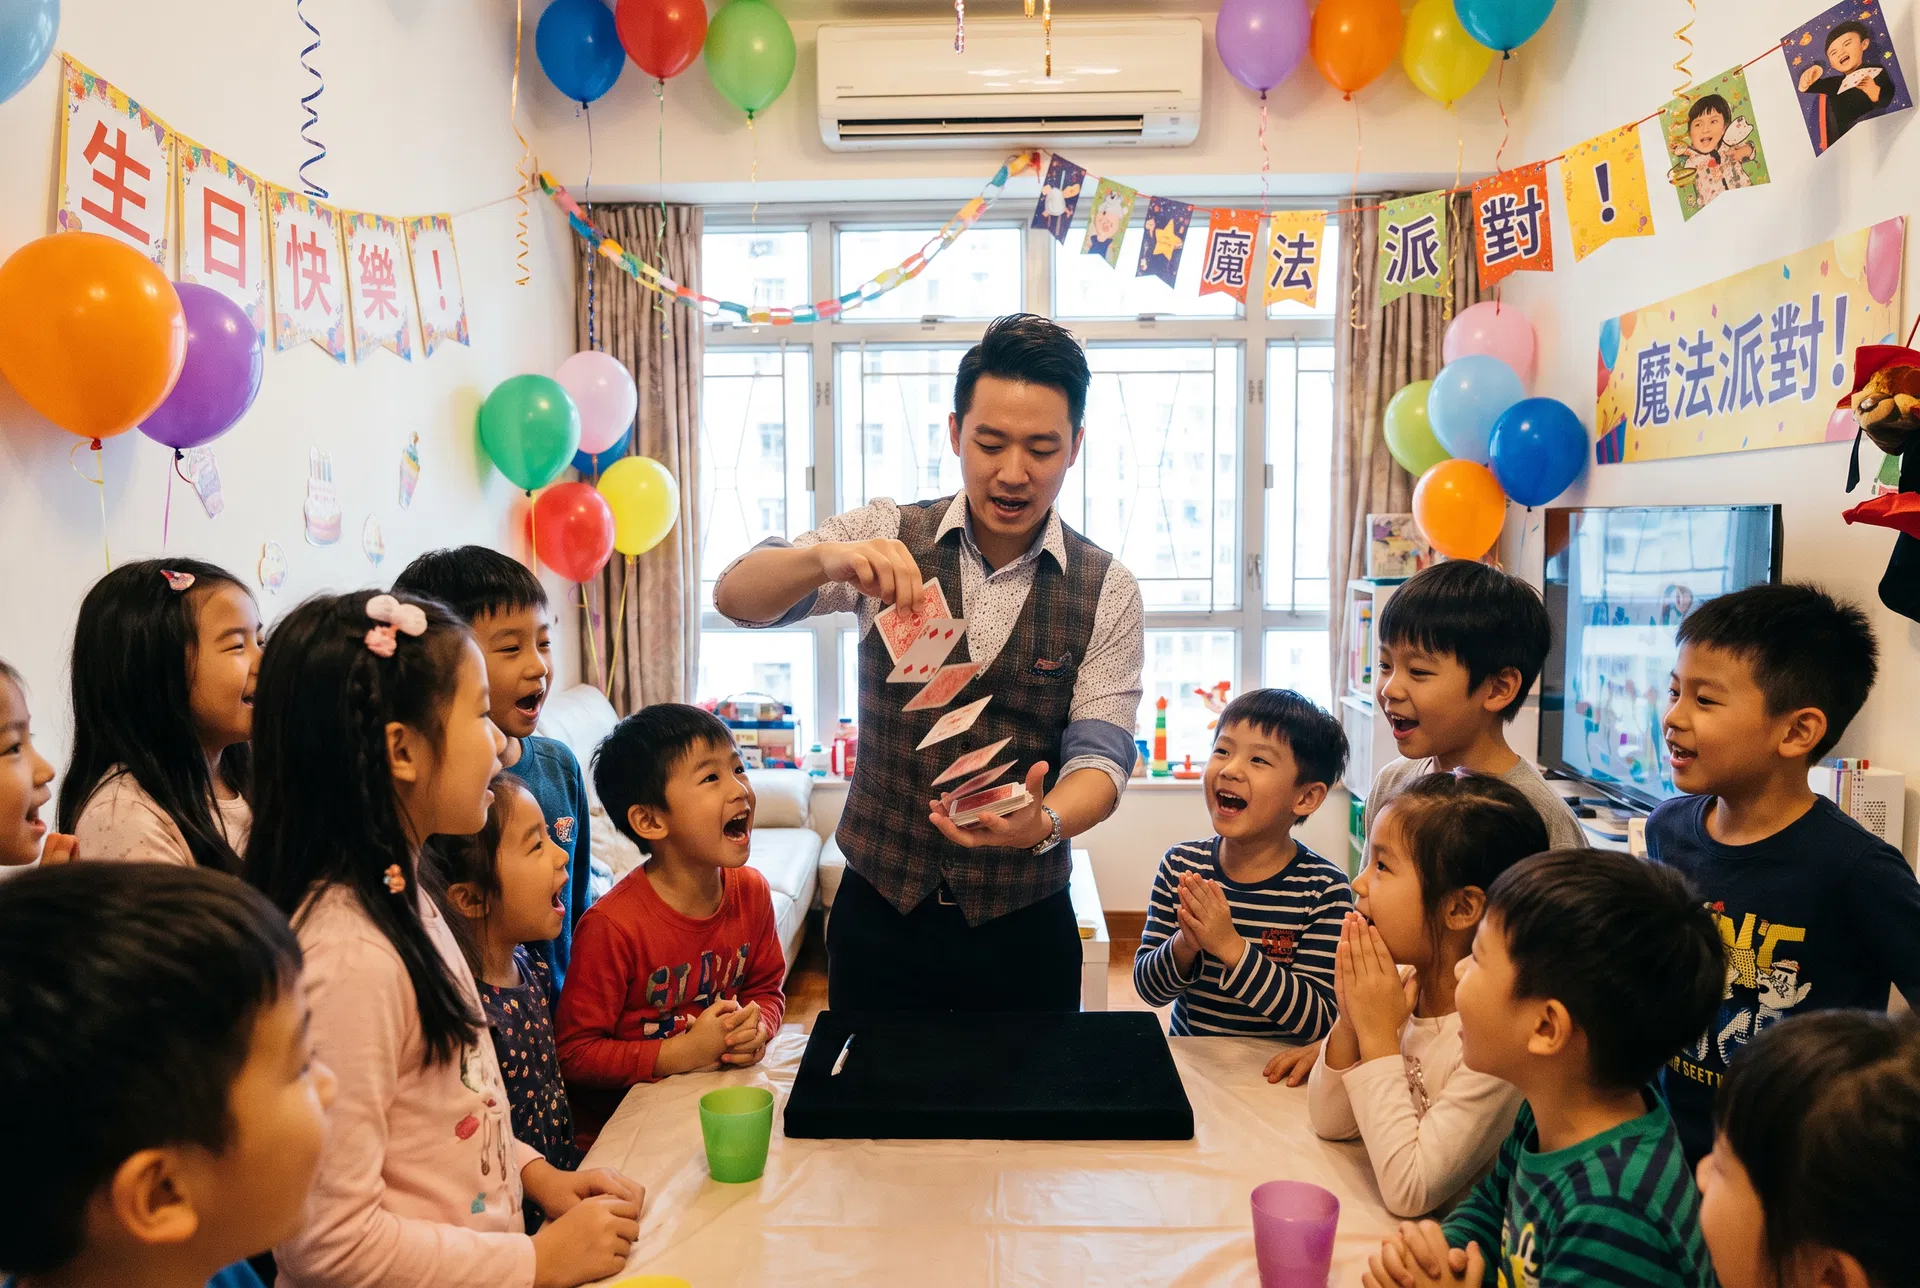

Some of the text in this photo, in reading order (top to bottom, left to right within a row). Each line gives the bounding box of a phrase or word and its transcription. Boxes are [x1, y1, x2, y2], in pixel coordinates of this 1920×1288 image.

[81, 120, 447, 320] 生日快樂！
[1632, 294, 1848, 428] 魔法派對！
[1682, 1060, 1714, 1086] SEET
